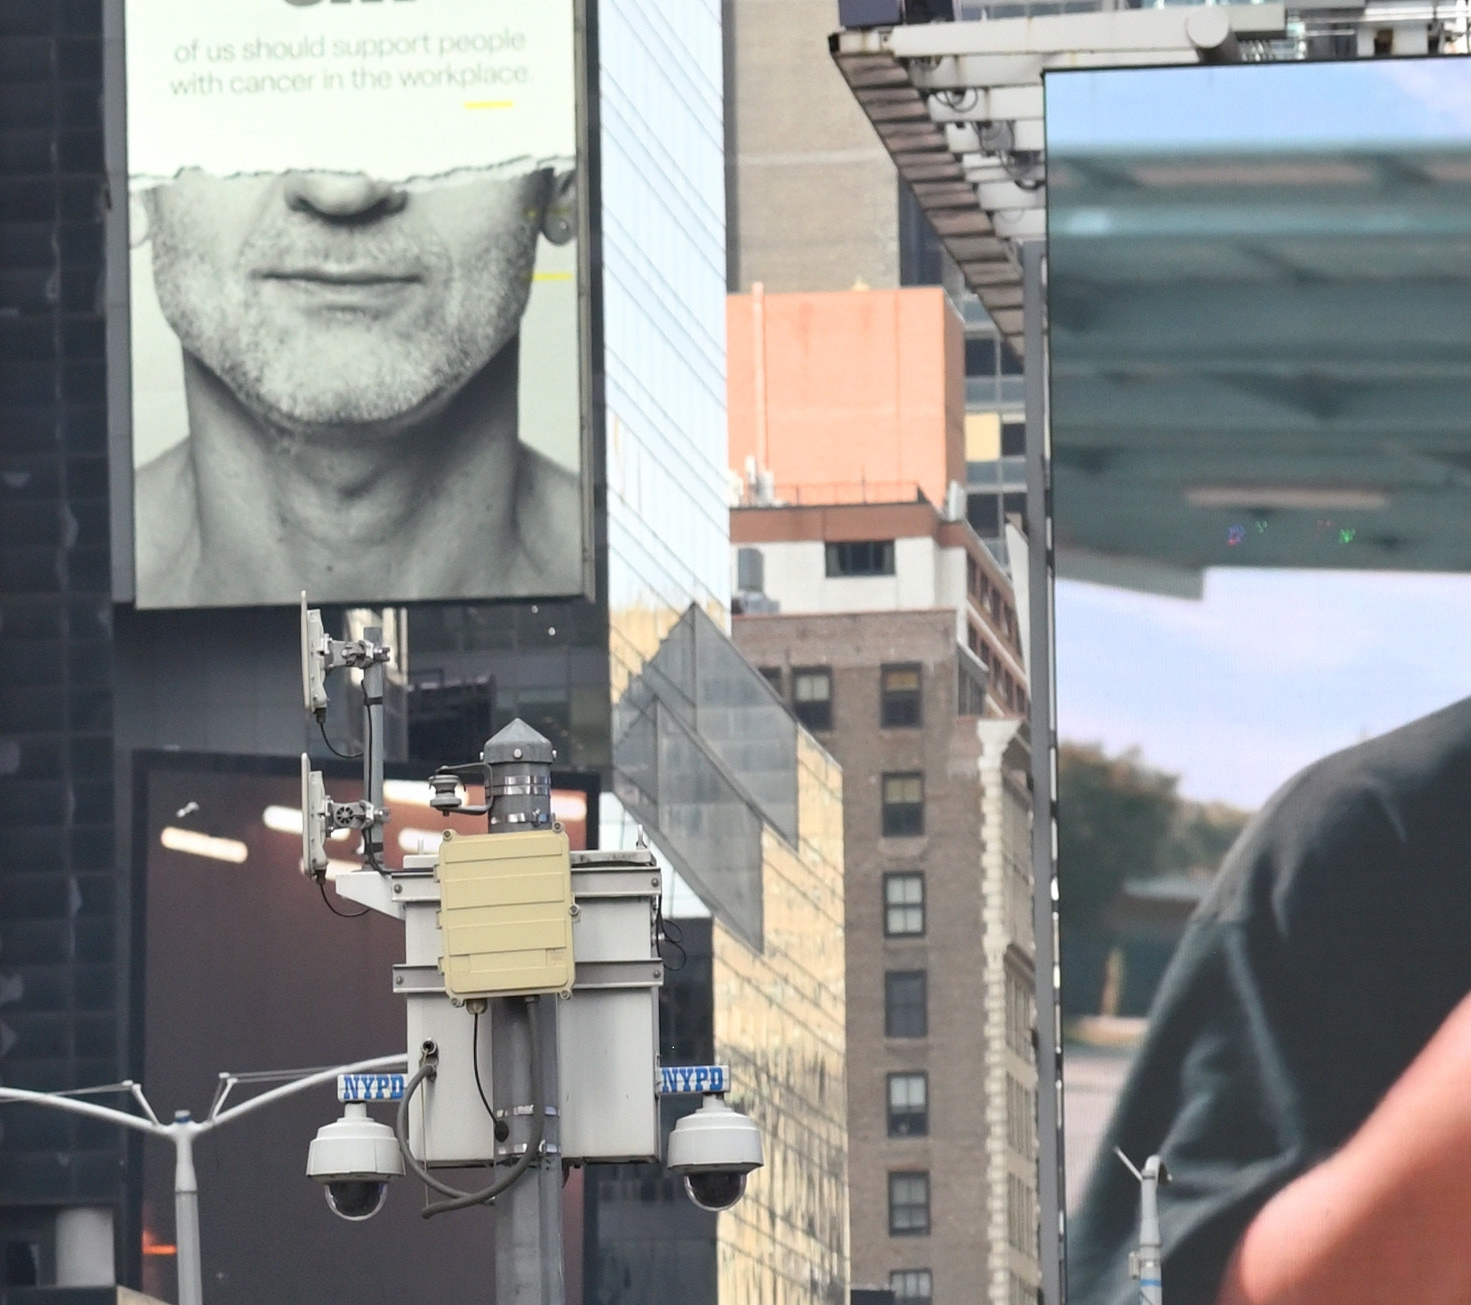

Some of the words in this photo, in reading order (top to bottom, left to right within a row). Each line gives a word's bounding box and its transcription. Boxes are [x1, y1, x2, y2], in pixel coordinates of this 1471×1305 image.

[174, 43, 199, 63] of
[203, 46, 234, 63] us
[241, 36, 326, 62] should
[331, 33, 429, 64] support
[437, 29, 526, 60] people
[169, 71, 224, 97] with
[228, 73, 311, 94] cancer
[323, 67, 344, 92] in
[350, 65, 393, 91] the
[342, 1076, 405, 1099] NYPD
[661, 1067, 724, 1091] NYPD
